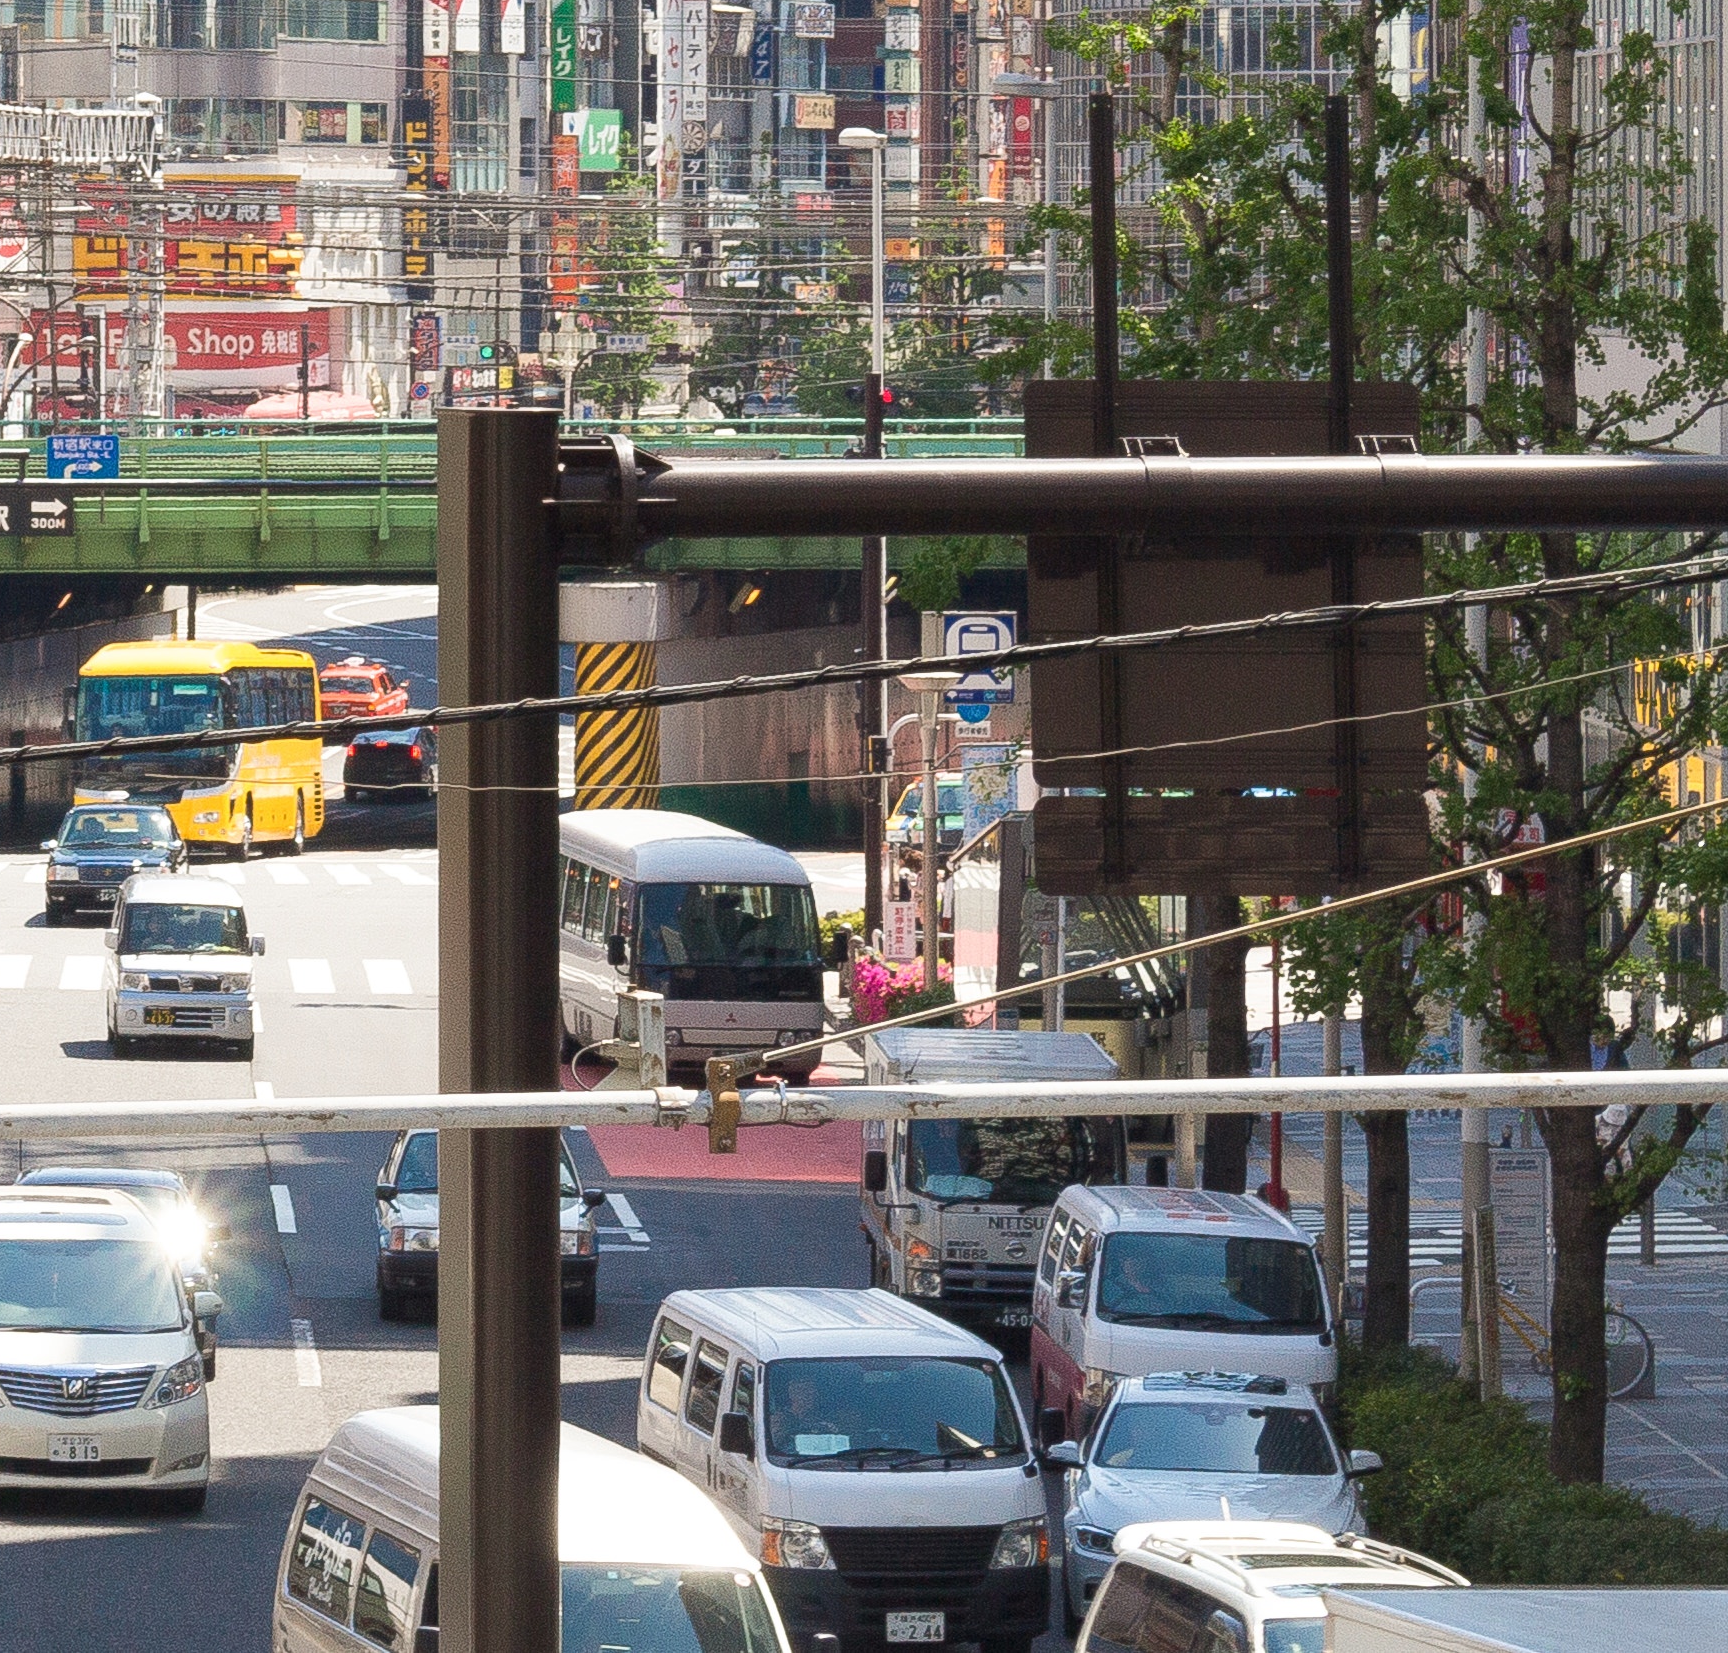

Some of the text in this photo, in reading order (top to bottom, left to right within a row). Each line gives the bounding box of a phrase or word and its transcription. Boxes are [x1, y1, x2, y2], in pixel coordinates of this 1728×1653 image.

[555, 28, 572, 77] レイク
[686, 9, 703, 95] パーティー
[588, 123, 619, 157] レイク
[187, 327, 255, 360] Shop
[31, 517, 66, 529] 300M
